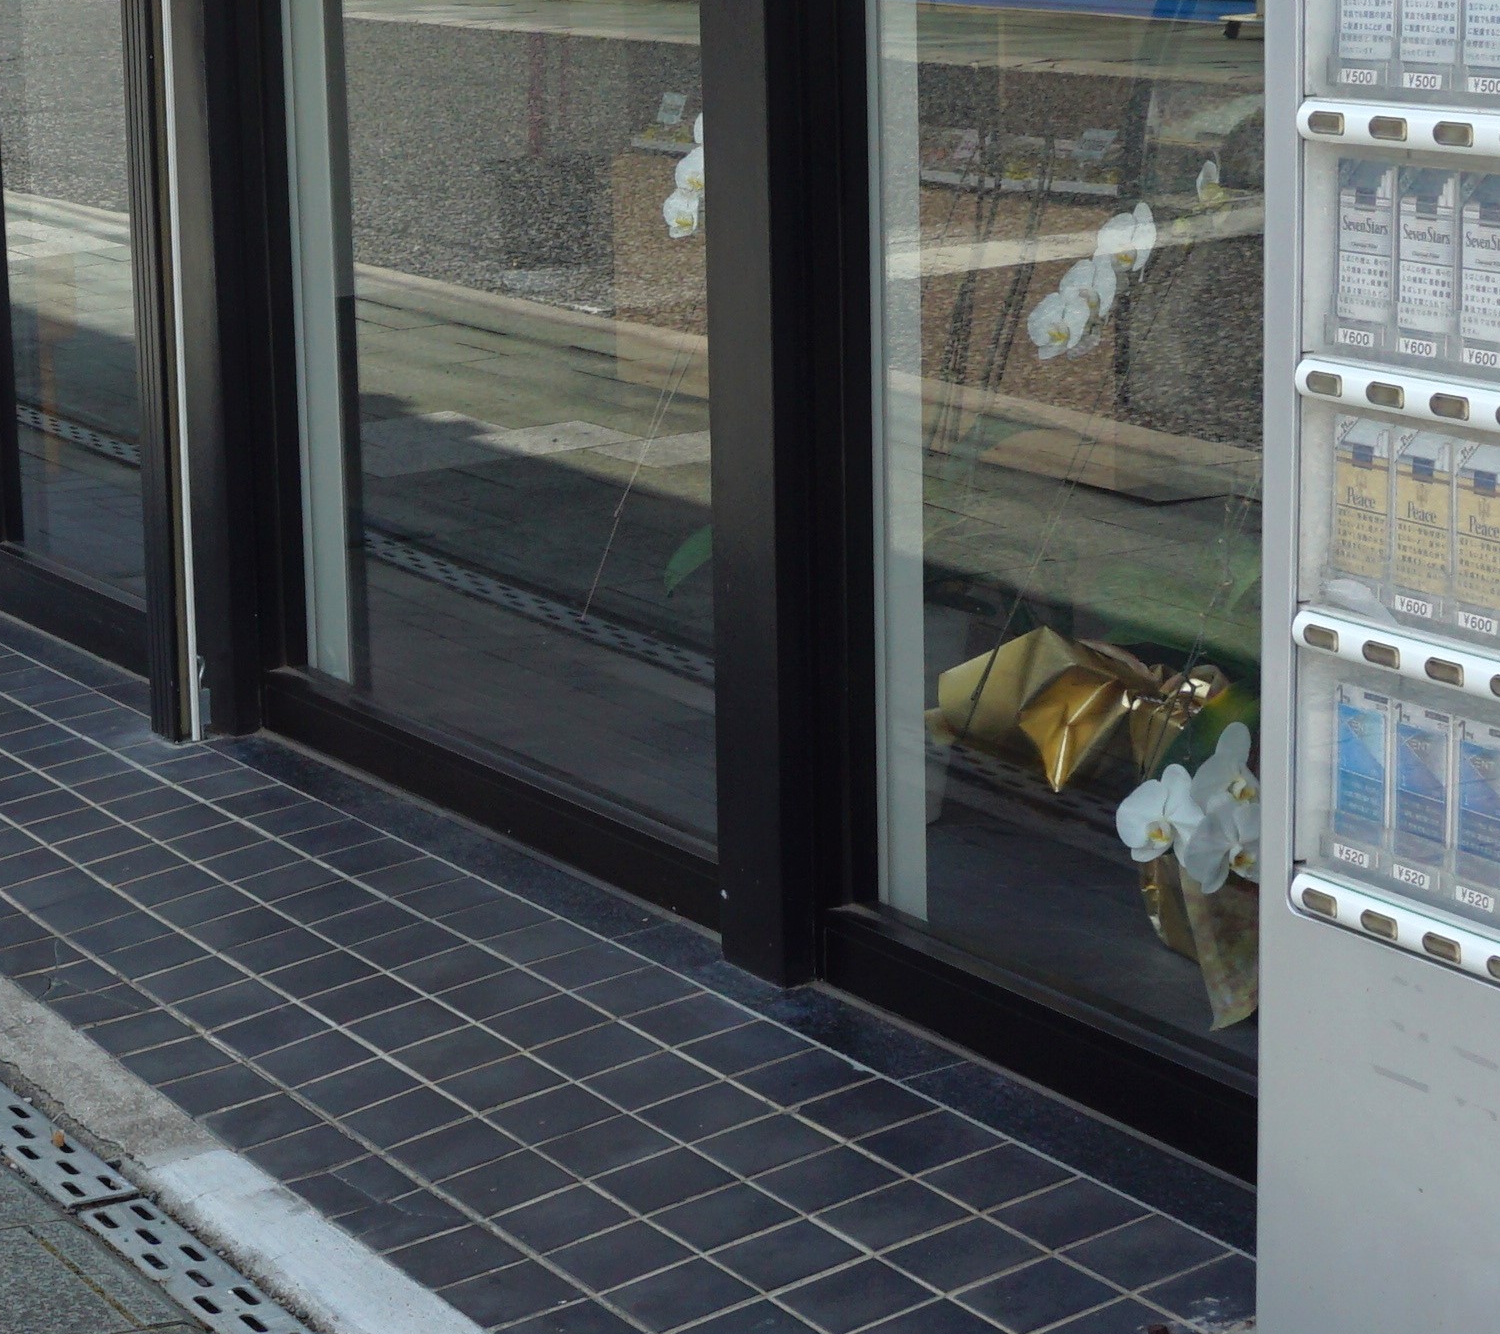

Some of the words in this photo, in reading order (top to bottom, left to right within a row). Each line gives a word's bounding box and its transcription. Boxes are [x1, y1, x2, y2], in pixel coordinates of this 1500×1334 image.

[1345, 70, 1373, 84] ¥500
[1408, 74, 1437, 88] ¥500
[1342, 330, 1370, 347] ¥600
[1403, 340, 1432, 355] ¥600
[1468, 349, 1498, 366] ¥600
[1347, 486, 1376, 510] Peace
[1407, 500, 1437, 525] Peace
[1469, 514, 1500, 539] Peace
[1400, 598, 1428, 616] ¥600
[1463, 613, 1493, 633] ¥600
[1338, 847, 1365, 866] ¥520
[1398, 868, 1427, 888] ¥520
[1460, 888, 1490, 910] ¥520
